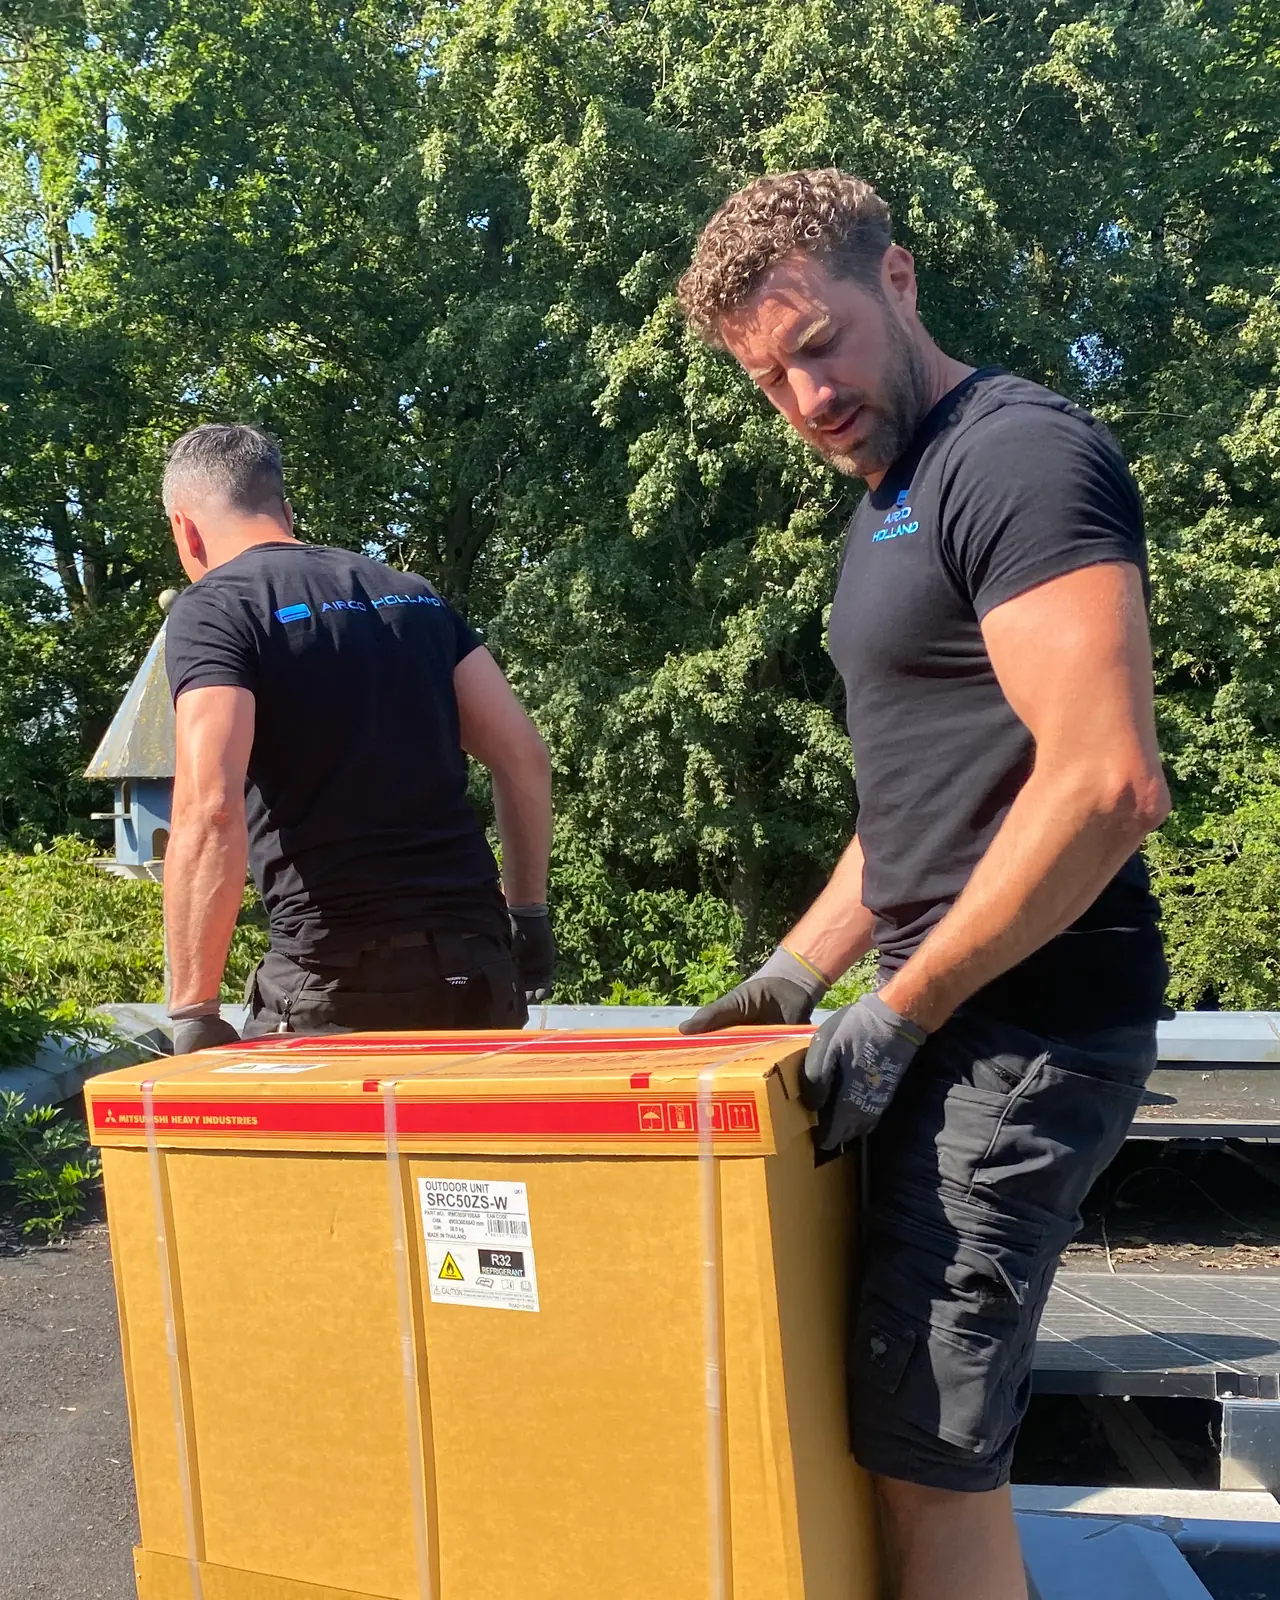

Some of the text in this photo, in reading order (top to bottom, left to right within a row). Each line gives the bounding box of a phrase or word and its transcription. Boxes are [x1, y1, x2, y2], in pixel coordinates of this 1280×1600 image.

[872, 521, 919, 542] HOLLAND
[321, 594, 441, 612] AIRCO HOLLAND
[118, 1114, 258, 1125] MITSUSHI HEAVY INDUSTRIES
[425, 1181, 490, 1194] OUTDOOR UNIT
[427, 1193, 508, 1210] SRC50ZS-W
[445, 1233, 467, 1241] THAILAND
[491, 1254, 512, 1267] R32
[481, 1268, 524, 1276] REFRIGERANT
